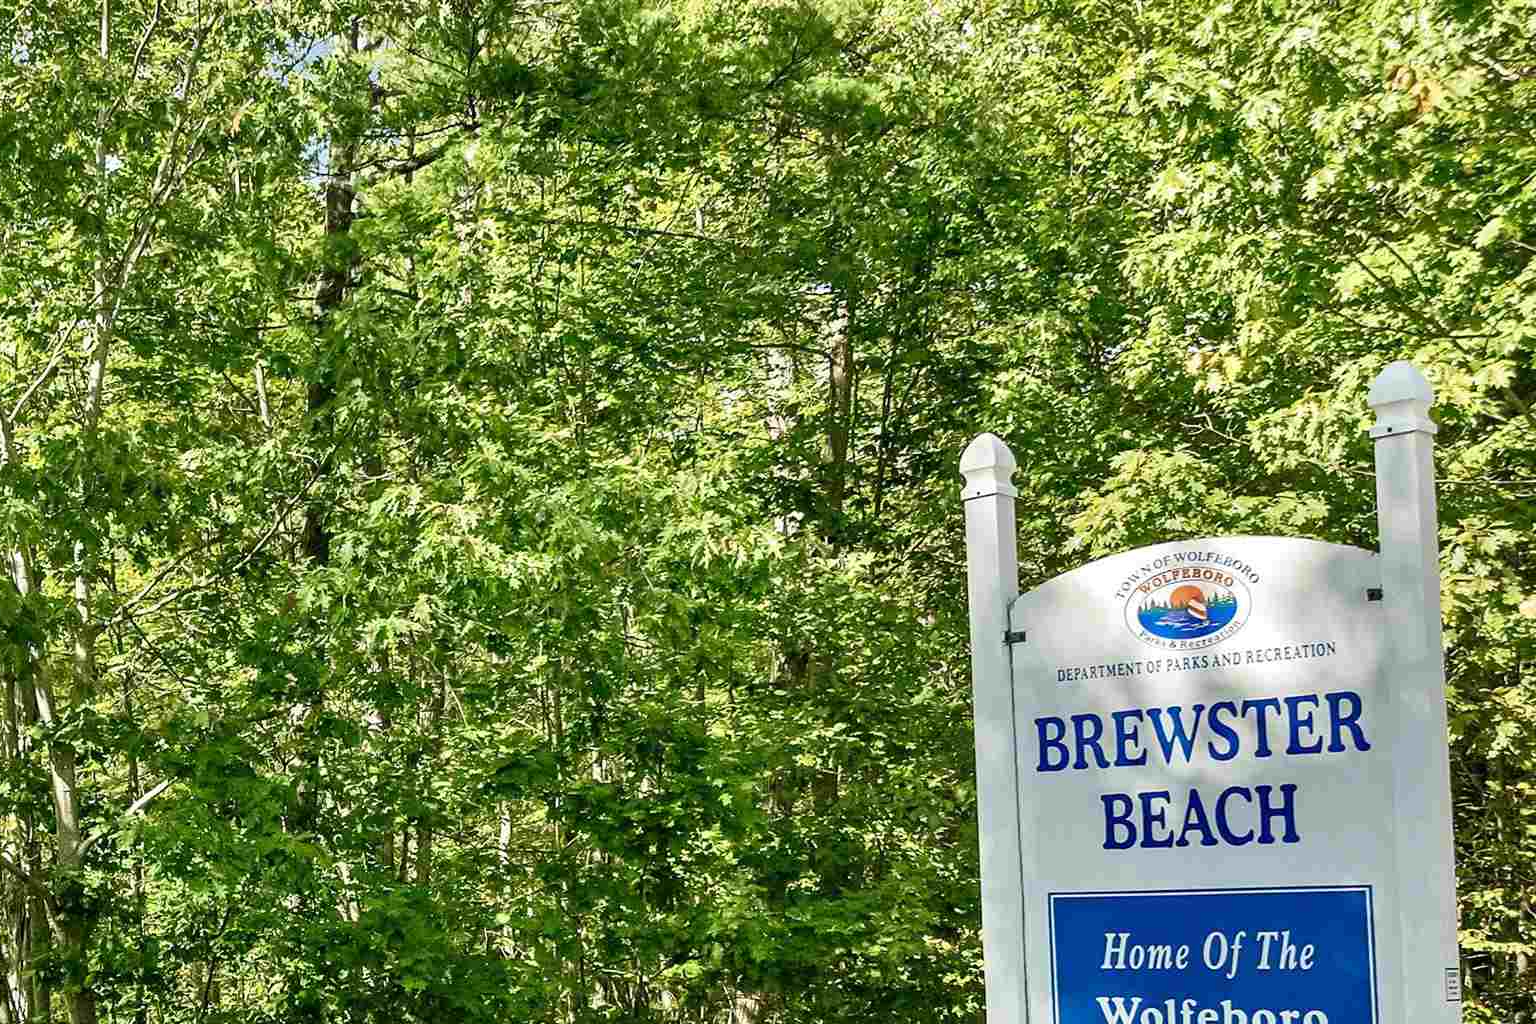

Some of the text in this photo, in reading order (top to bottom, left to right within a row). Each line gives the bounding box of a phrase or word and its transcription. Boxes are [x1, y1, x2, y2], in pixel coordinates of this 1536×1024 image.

[1115, 551, 1260, 599] TOWN OF WOLFEBORO
[1137, 568, 1234, 593] WOLFEBORO
[1057, 641, 1336, 681] DEPARTMENT OF PARKS AND RECREATION
[1034, 691, 1371, 772] BREWSTER
[1100, 783, 1300, 850] BEACH
[1100, 930, 1315, 979] Home Of The
